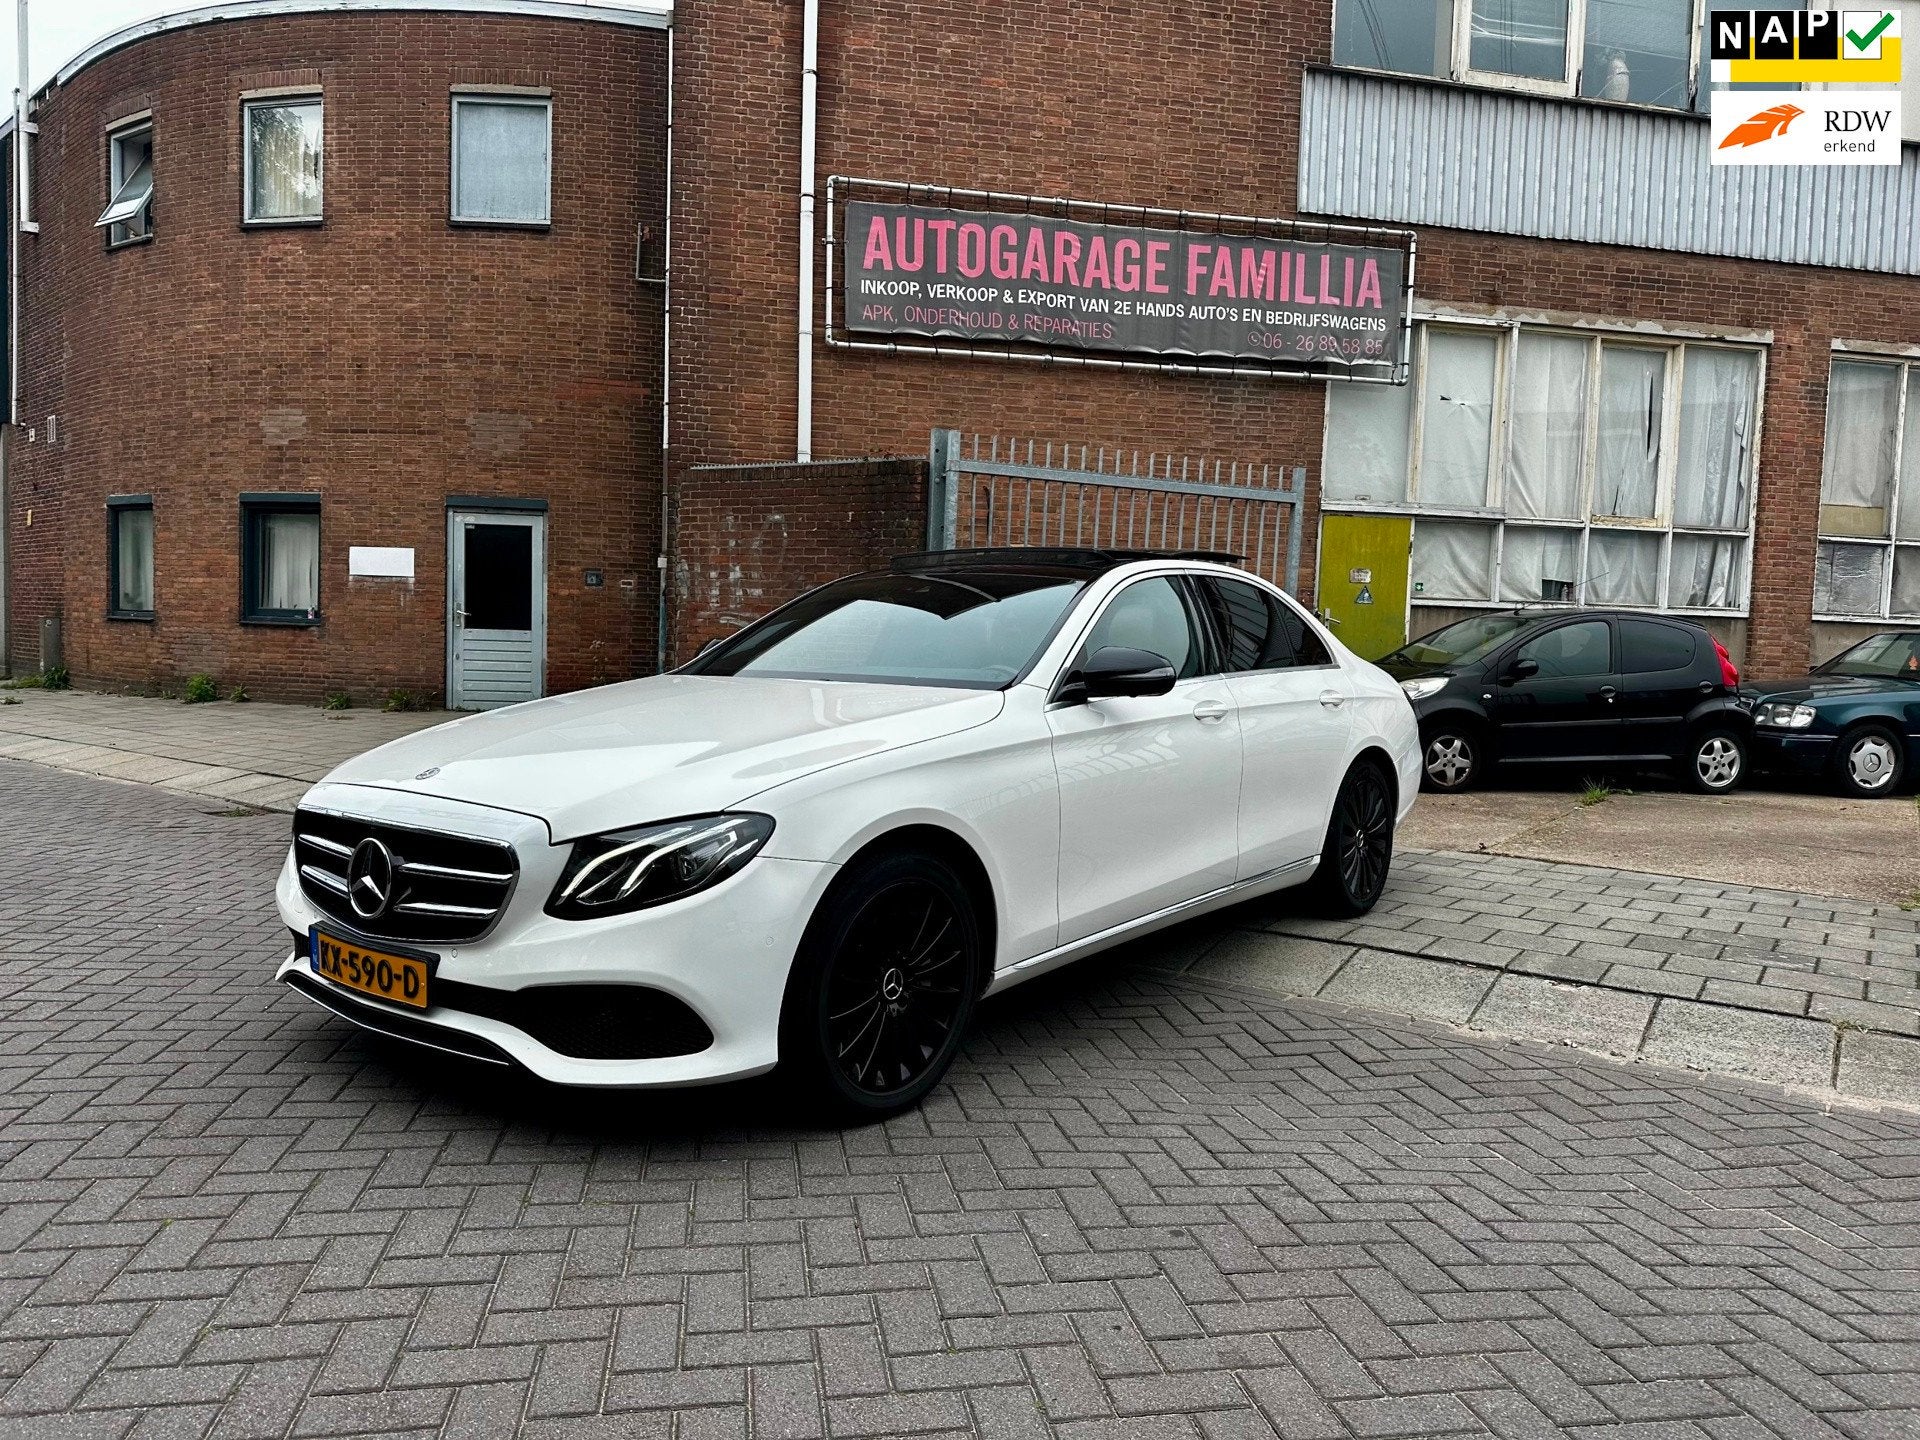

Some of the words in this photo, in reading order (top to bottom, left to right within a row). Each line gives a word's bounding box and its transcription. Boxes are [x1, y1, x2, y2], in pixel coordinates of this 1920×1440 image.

[862, 215, 1171, 294] AUTOGARAGE
[1186, 243, 1383, 309] FAMILLIA
[860, 279, 922, 299] INKOOP,
[927, 283, 999, 302] VERKOOP
[1002, 289, 1014, 304] &
[1018, 289, 1076, 309] EXPORT
[1080, 297, 1109, 313] VAN
[1114, 300, 1132, 315] 2E
[1136, 301, 1185, 318] HANDS
[1188, 305, 1238, 322] AUTO'S
[1242, 308, 1262, 323] EN
[1266, 310, 1386, 331] BEDRIJFSWAGENS
[862, 304, 898, 325] APK,
[904, 306, 1003, 330] ONDERHOUD
[1008, 314, 1019, 330] &
[1024, 314, 1112, 339] REPARATIES
[1263, 332, 1282, 349] 06
[1296, 334, 1314, 351] 26
[1318, 335, 1337, 352] 89
[1342, 338, 1360, 354] 58
[1365, 338, 1383, 355] 85
